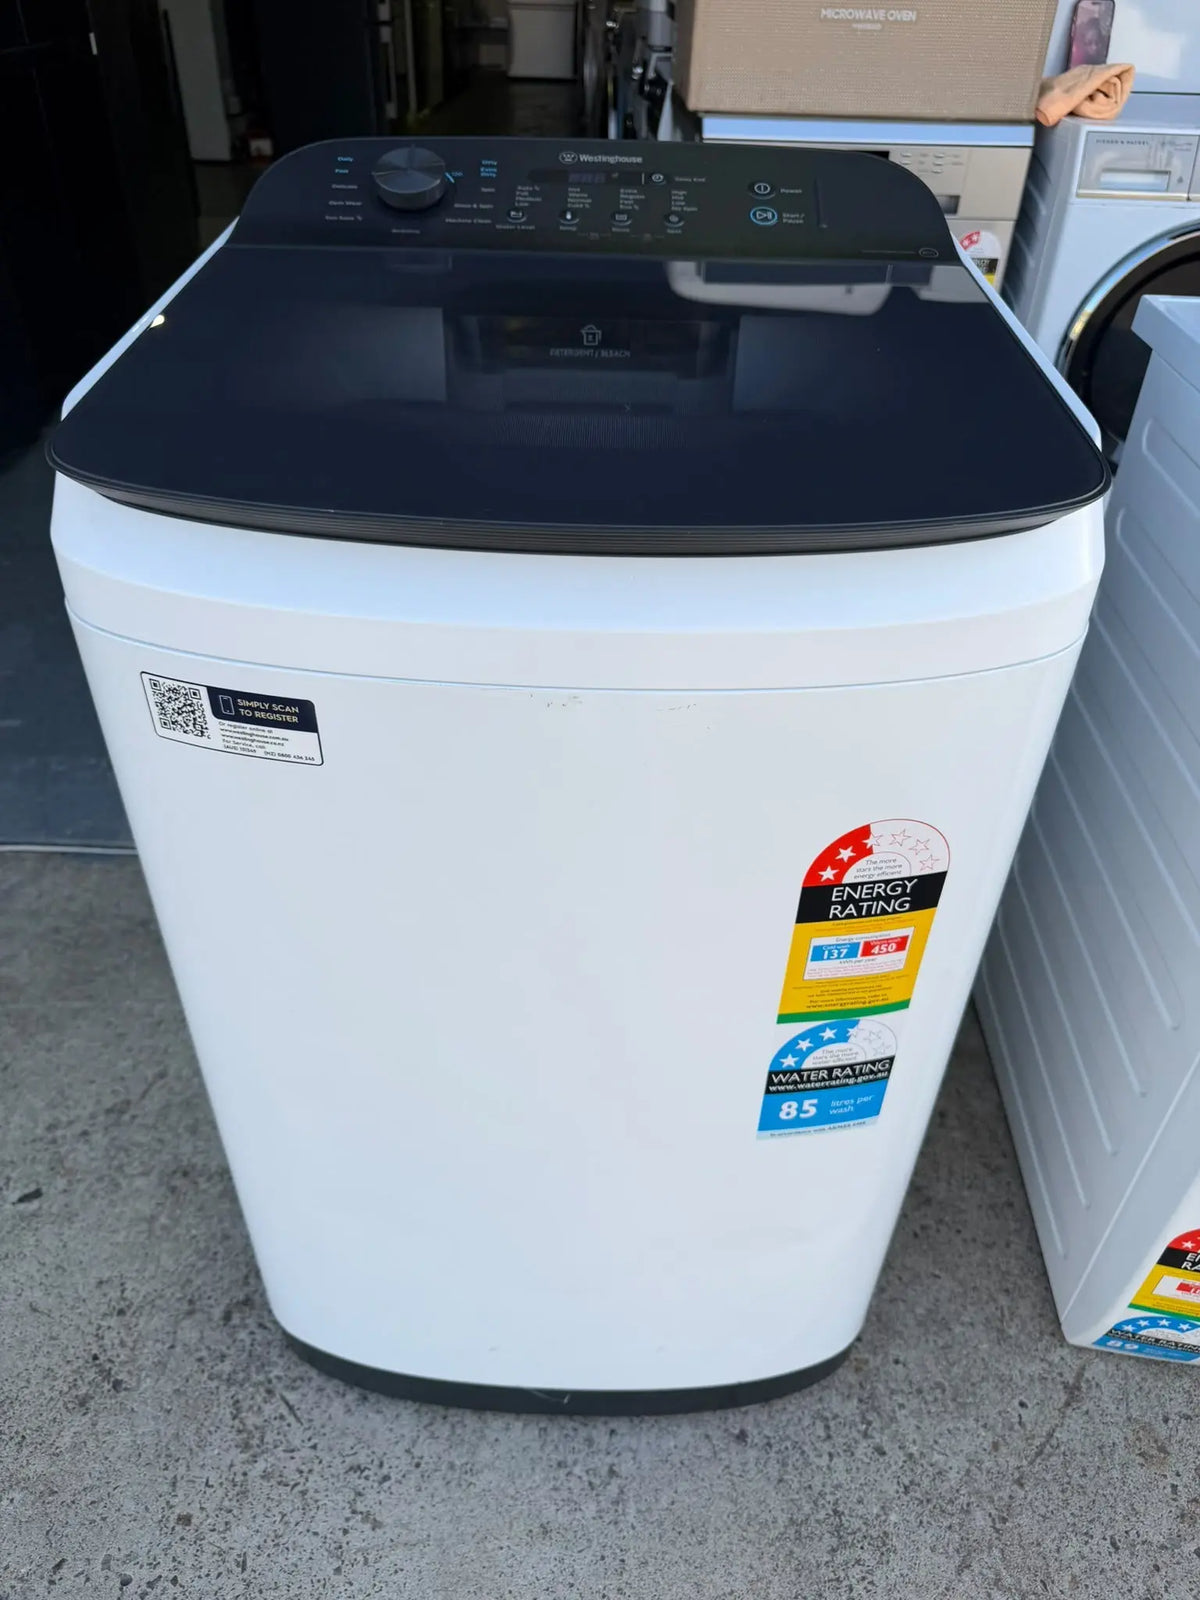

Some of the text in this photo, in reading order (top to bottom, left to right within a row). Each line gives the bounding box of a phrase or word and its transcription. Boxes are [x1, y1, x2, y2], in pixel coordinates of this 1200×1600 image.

[820, 8, 917, 22] MICROWAVE OVEN
[579, 154, 643, 164] Westinghouse
[549, 348, 594, 357] DETERGENT
[600, 349, 631, 358] BLEACH
[237, 699, 299, 713] SIMPLY SCAN
[239, 708, 298, 723] TO REGISTER
[876, 869, 902, 878] efficient
[831, 878, 918, 902] ENERGY
[828, 897, 912, 919] RATING
[823, 948, 848, 960] 137
[871, 942, 896, 955] 450
[771, 1060, 890, 1084] WATER RATING
[768, 1071, 888, 1092] www.waterrating.gov.au
[830, 1094, 875, 1107] litres per
[778, 1098, 818, 1120] 85
[828, 1105, 854, 1115] wash
[1110, 1329, 1156, 1342] WATER
